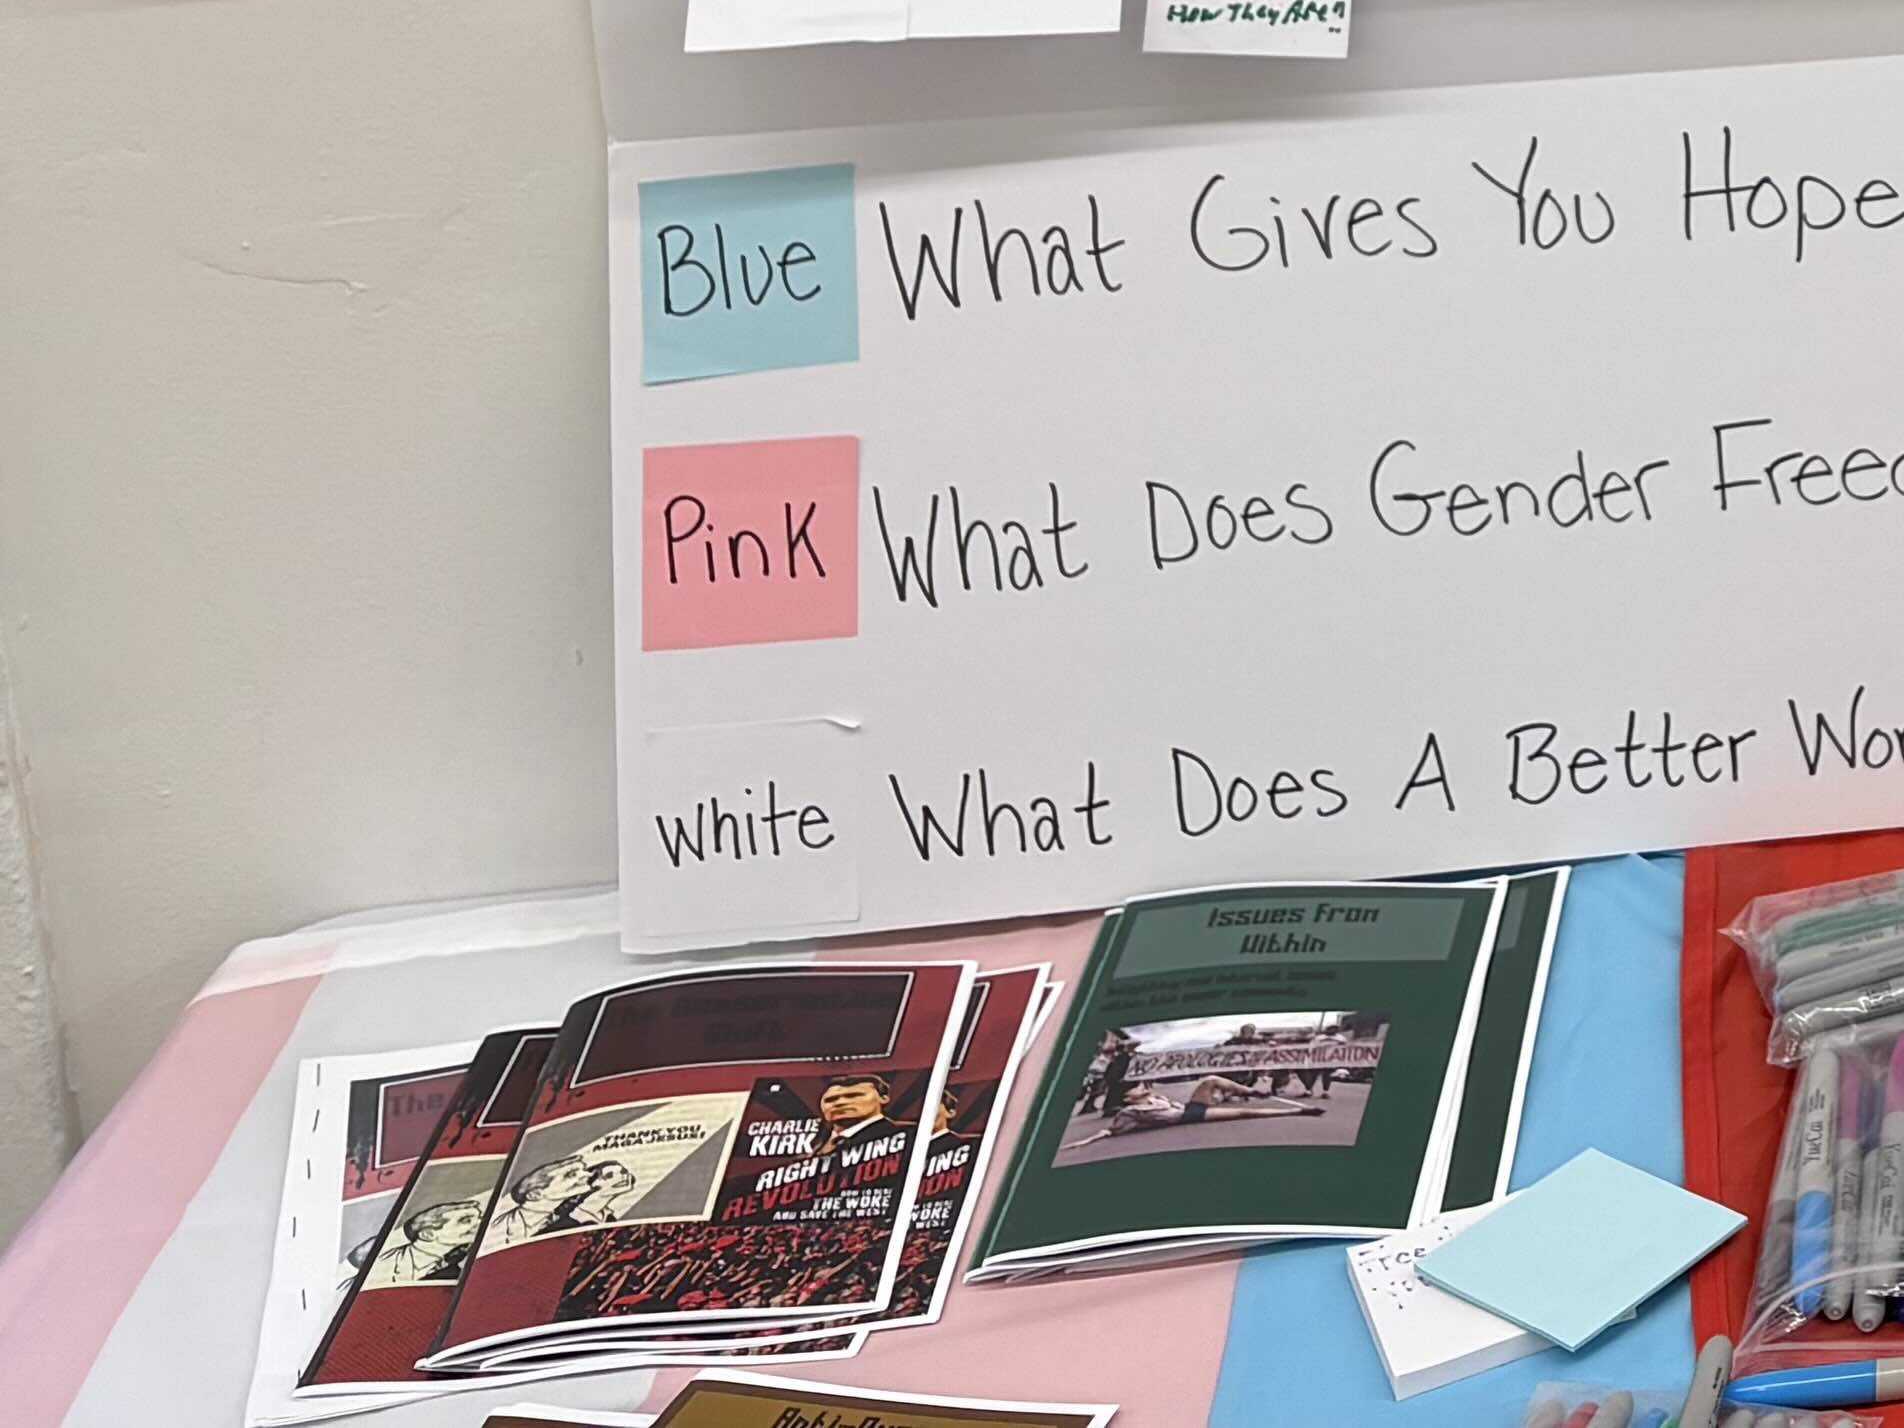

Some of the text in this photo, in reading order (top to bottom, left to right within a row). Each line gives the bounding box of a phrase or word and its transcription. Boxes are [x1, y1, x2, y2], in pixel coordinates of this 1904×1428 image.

[657, 222, 823, 321] Blue
[878, 193, 1125, 322] What
[1189, 171, 1440, 273] Gives
[1470, 135, 1617, 252] You
[661, 493, 830, 589] Pink
[870, 481, 1090, 610] What
[1145, 477, 1336, 575] Does
[1369, 437, 1670, 538] Gender
[656, 786, 836, 870] white
[886, 760, 1115, 863] What
[1170, 746, 1350, 840] Does
[1395, 732, 1458, 814] A
[1504, 709, 1759, 809] Better
[1207, 906, 1305, 928] Issues
[1240, 933, 1327, 955] Within
[605, 1124, 701, 1143] THANK YOU
[748, 1118, 822, 1136] CHARLIE
[749, 1132, 818, 1157] KIRK
[755, 1132, 907, 1192] RIGHT WING
[721, 1155, 900, 1220] REVOLUION
[812, 1195, 890, 1210] THE WOKE
